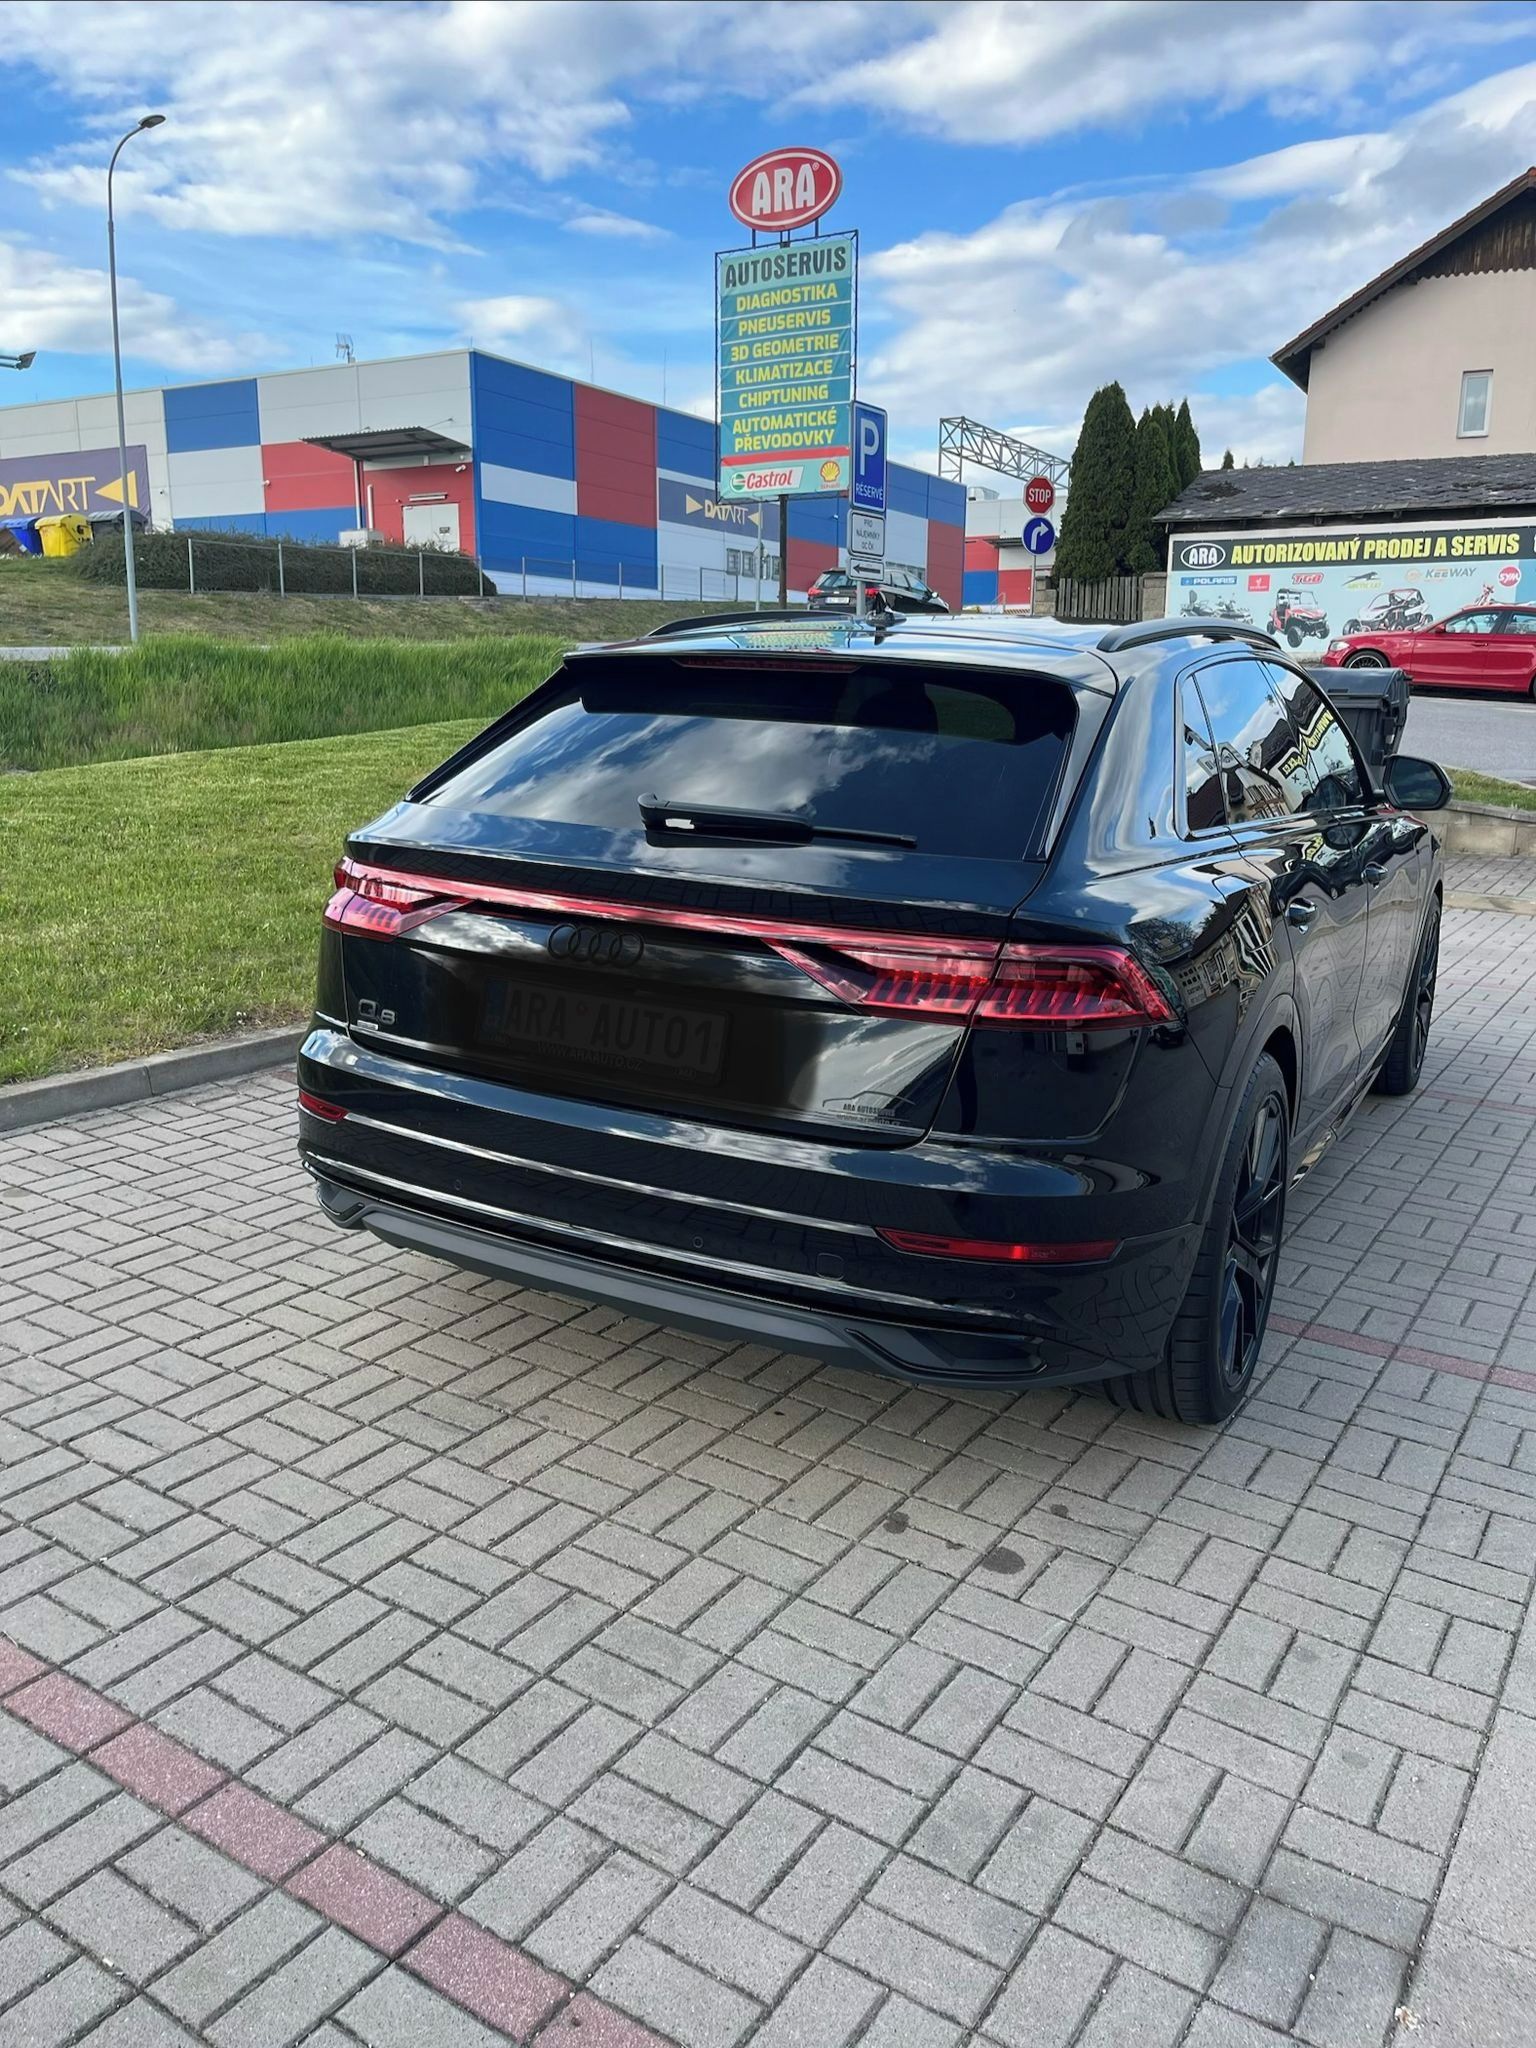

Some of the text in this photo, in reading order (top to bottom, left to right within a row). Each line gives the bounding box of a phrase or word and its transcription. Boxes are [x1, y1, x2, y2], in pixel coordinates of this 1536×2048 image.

[752, 163, 816, 217] ARA
[725, 246, 847, 288] AUTOSERVIS
[736, 283, 838, 313] DIAGNOSTIKA
[738, 309, 831, 336] PNEUSERVIS
[731, 333, 839, 361] 3D GEOMETRIE
[735, 359, 833, 385] KLIMATIZACE
[739, 384, 829, 409] CHIPTUNING
[733, 406, 837, 434] AUTOMATICKÉ
[735, 429, 835, 453] PŘEVODOVKY
[860, 418, 880, 476] P
[746, 469, 794, 490] Castrol
[1028, 488, 1051, 504] STOP
[704, 499, 749, 525] DATART
[1188, 547, 1218, 565] ARA
[1230, 537, 1361, 565] AUTORIZOVANÝ
[1363, 538, 1430, 560] PRODEJ
[1433, 537, 1447, 557] A
[1451, 533, 1520, 556] SERVIS
[1193, 576, 1236, 585] POLARIS
[1500, 572, 1520, 584] SYM
[358, 998, 396, 1025] Q8
[510, 989, 567, 1041] ARA
